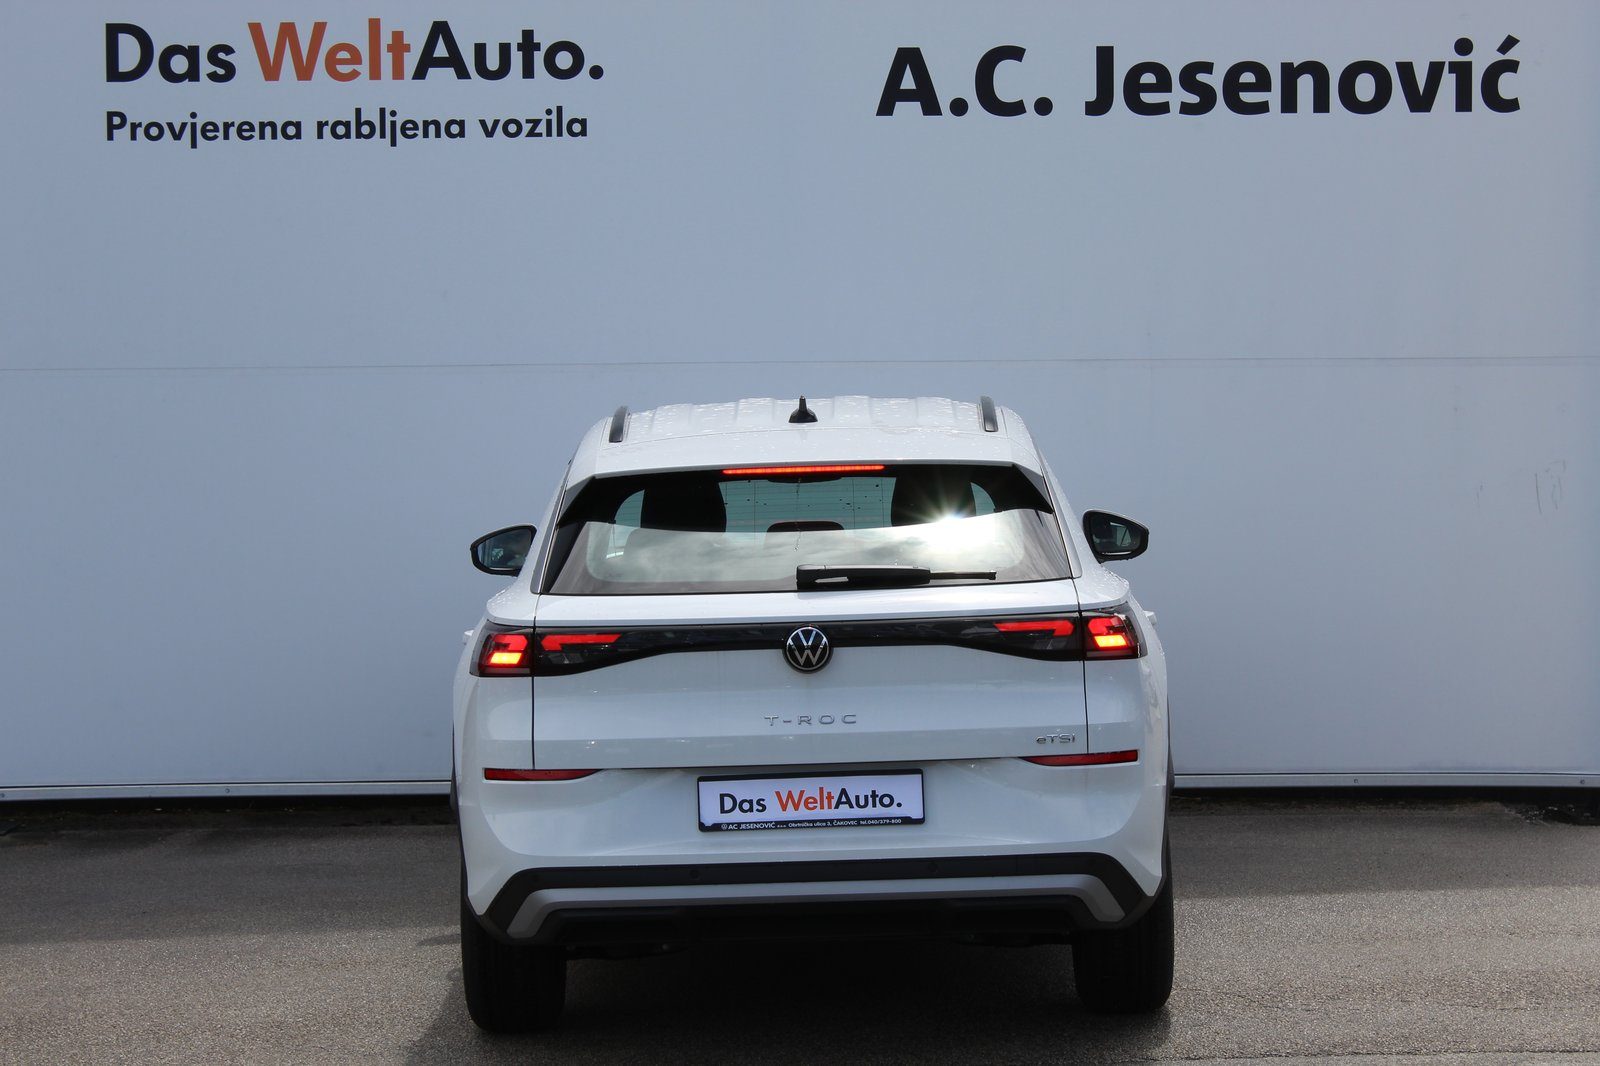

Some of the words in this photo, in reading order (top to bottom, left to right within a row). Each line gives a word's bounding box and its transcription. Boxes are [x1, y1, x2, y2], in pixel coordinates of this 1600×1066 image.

[105, 22, 237, 83] Das
[247, 17, 604, 82] WeltAuto.
[876, 44, 1054, 118] A.C.
[1084, 34, 1522, 117] Jesenović
[106, 110, 303, 149] Provjerena
[316, 107, 467, 147] rabljena
[478, 105, 589, 140] vozila
[764, 714, 857, 727] T-ROC
[719, 793, 767, 814] Das
[775, 786, 903, 812] WeltAuto.
